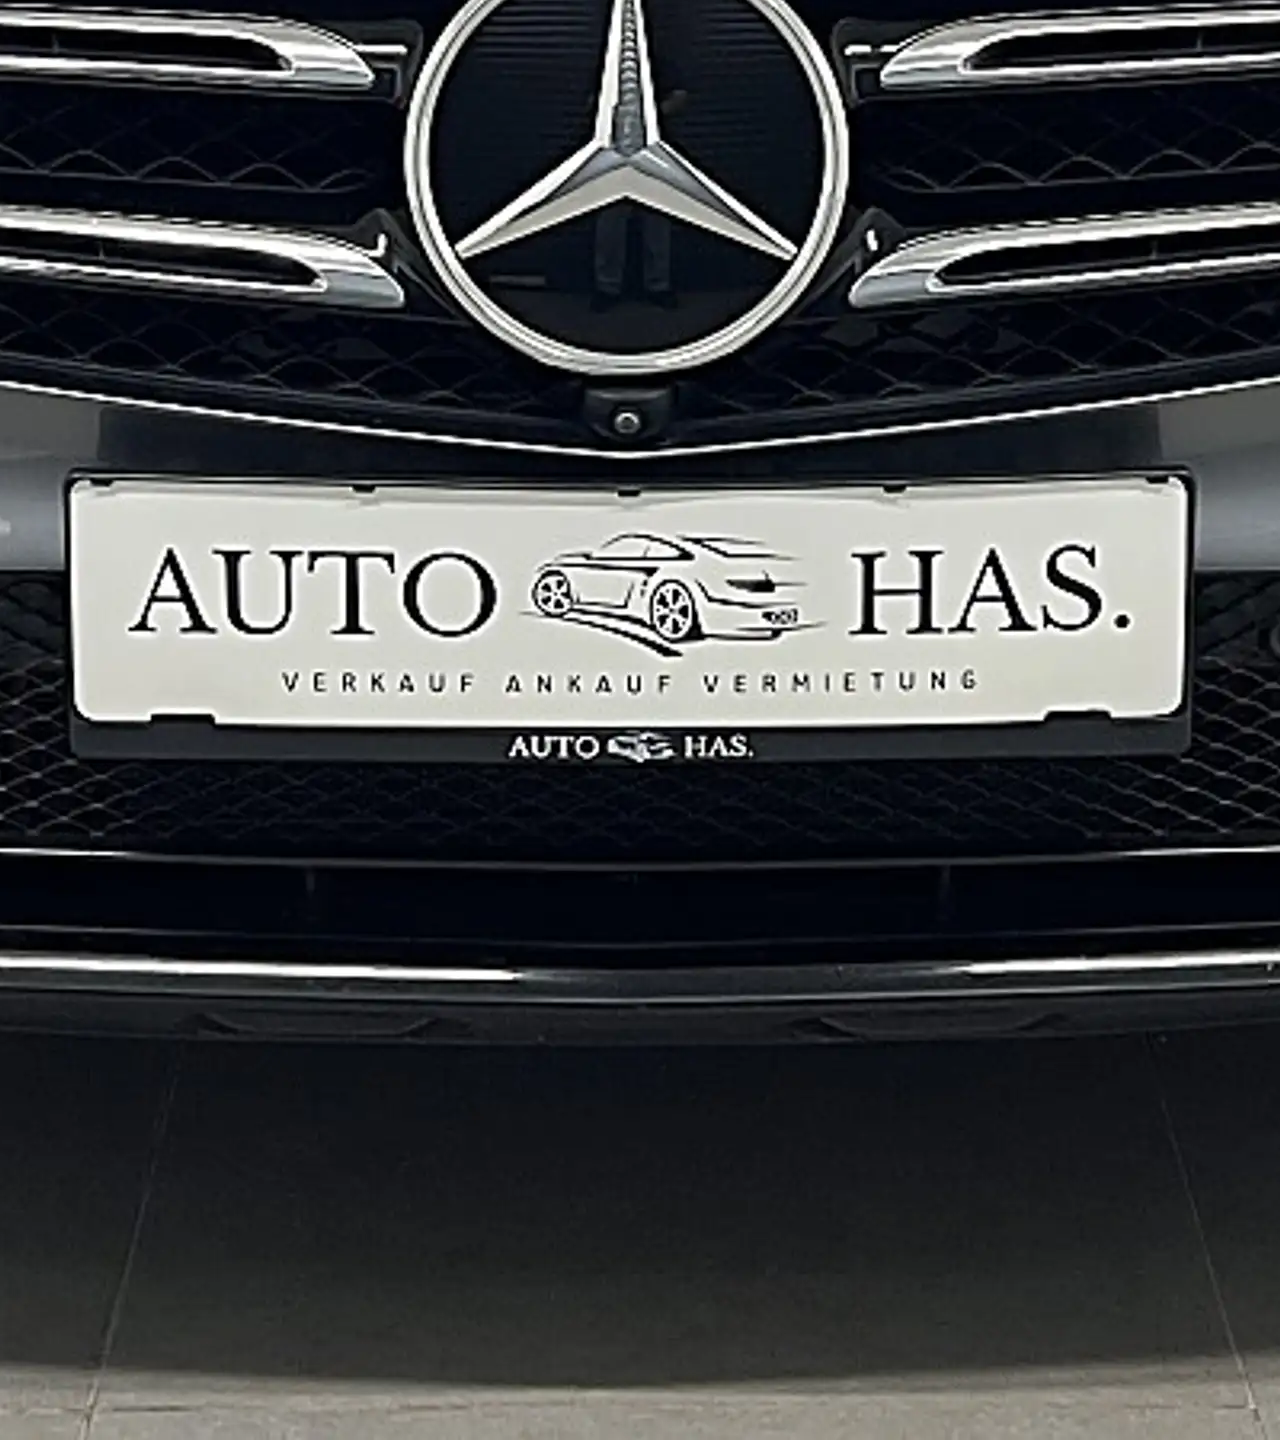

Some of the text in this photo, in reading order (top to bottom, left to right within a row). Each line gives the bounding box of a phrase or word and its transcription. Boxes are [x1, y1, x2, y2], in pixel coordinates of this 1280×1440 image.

[127, 543, 1131, 639] AUTO HAS.
[281, 668, 978, 694] VERKAUF ANKAUF VERMIETUNG
[508, 733, 754, 760] AUTO HAS.
